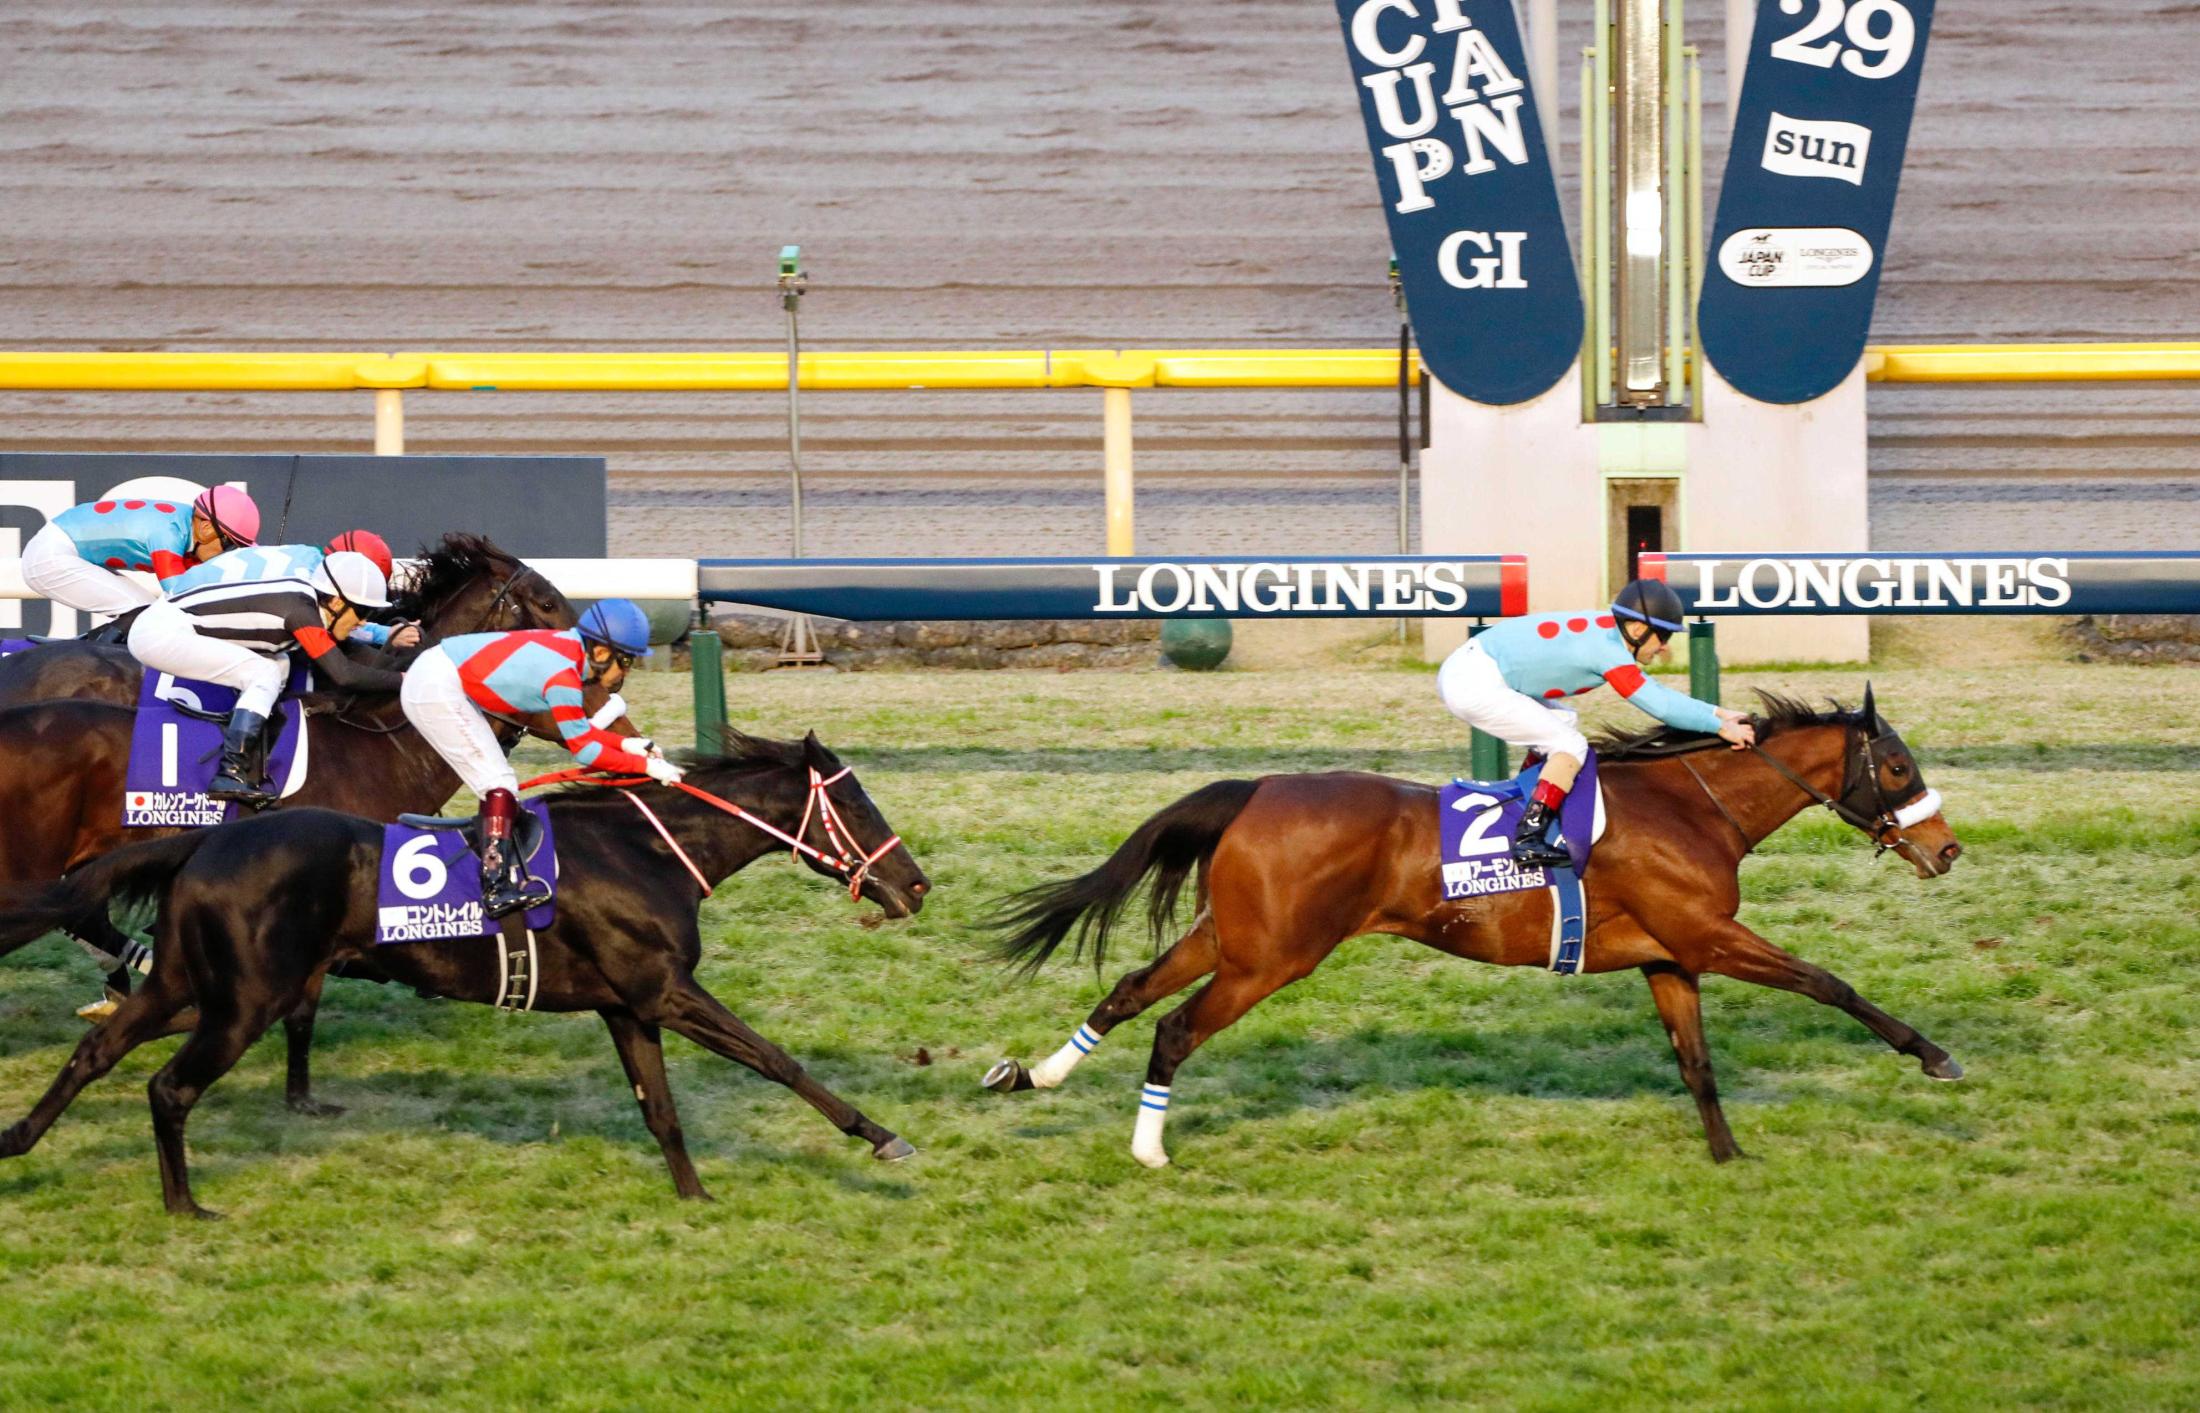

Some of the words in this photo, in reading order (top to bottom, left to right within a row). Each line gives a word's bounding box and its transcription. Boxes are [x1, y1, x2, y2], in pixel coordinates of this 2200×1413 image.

[1771, 0, 1916, 79] 29
[1773, 129, 1857, 169] sun
[1437, 229, 1528, 289] GI
[1738, 250, 1784, 264] JAPAN
[1748, 264, 1777, 277] CUP
[1092, 561, 1468, 613] LONGINES
[1693, 557, 2072, 609] LONGINES
[161, 722, 178, 787] 1
[127, 810, 224, 825] LONGINES
[1451, 792, 1510, 857] 2
[392, 834, 447, 900] 6
[1447, 872, 1546, 897] LONGINES
[382, 919, 484, 942] LONGINES
[408, 901, 483, 924] コントレイル
